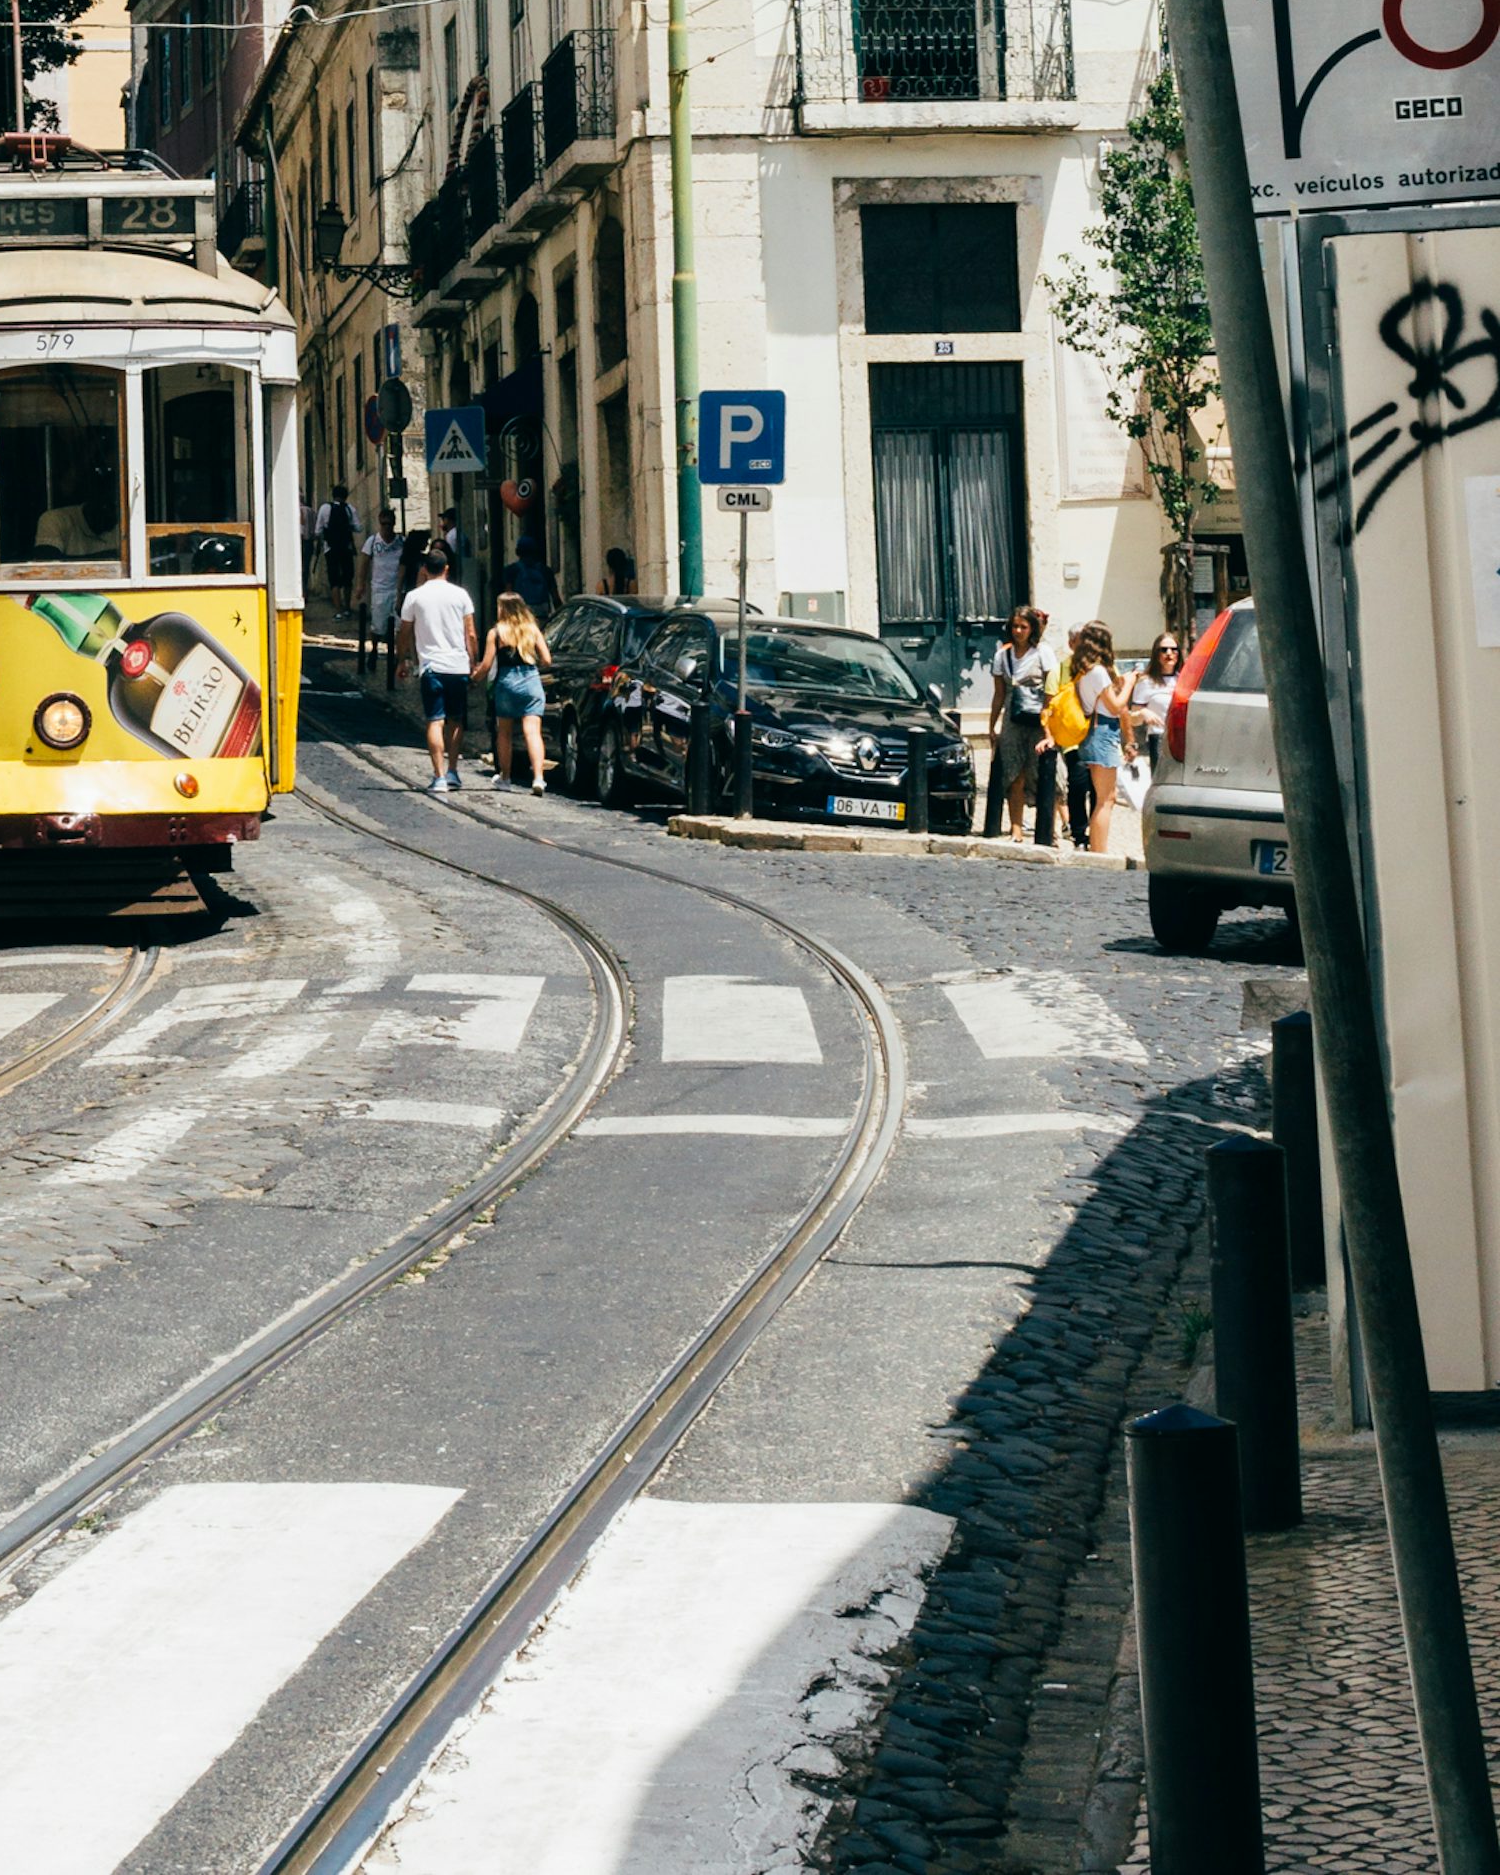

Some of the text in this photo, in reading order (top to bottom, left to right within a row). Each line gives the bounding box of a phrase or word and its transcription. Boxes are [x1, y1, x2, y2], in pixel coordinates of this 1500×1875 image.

[1250, 184, 1281, 198] xc.
[1294, 173, 1384, 195] veículos
[122, 197, 177, 229] 28
[36, 334, 75, 351] 579
[938, 342, 951, 354] 25
[719, 405, 764, 469] P
[725, 492, 761, 506] CML
[173, 666, 223, 745] BEIRÃO
